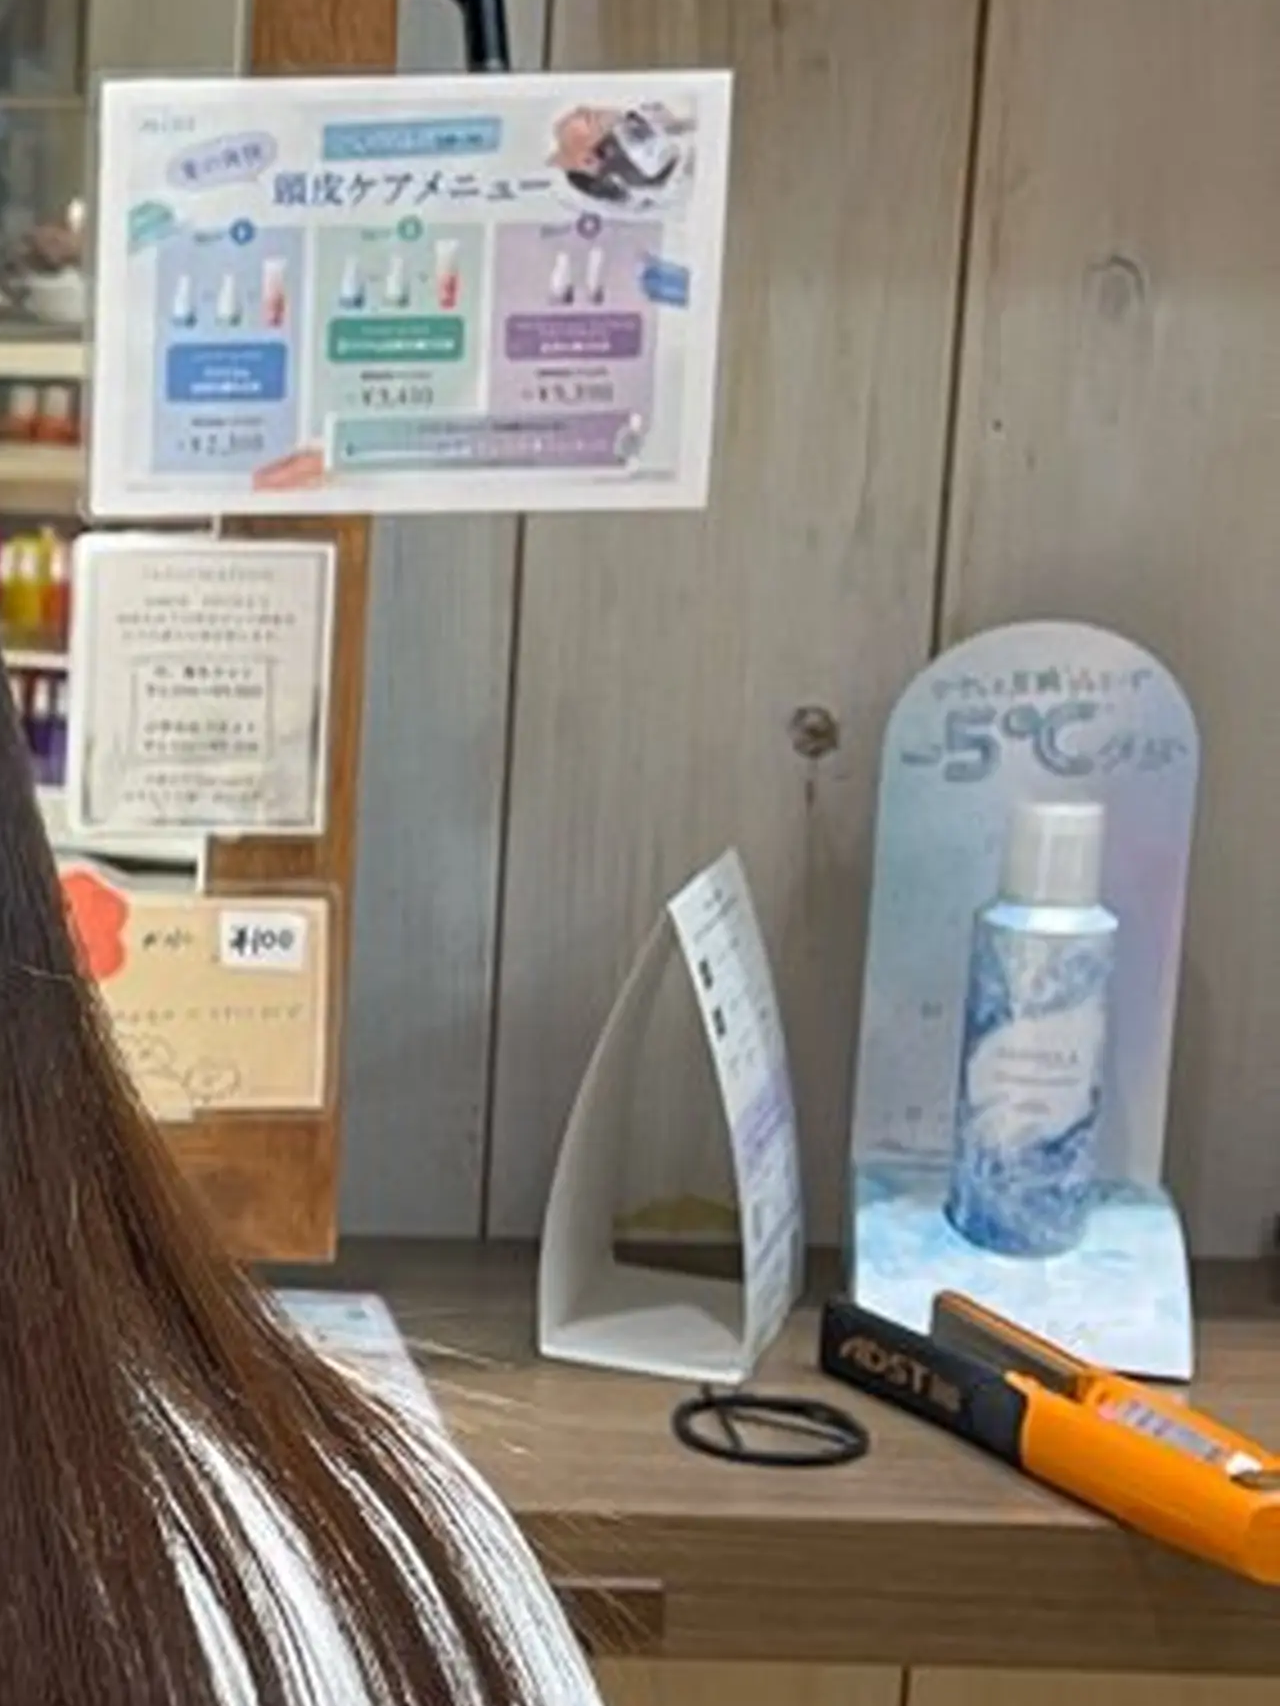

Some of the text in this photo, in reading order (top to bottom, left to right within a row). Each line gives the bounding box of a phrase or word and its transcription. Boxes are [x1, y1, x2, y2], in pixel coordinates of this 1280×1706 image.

[272, 170, 552, 206] 頭皮ケアメニュー
